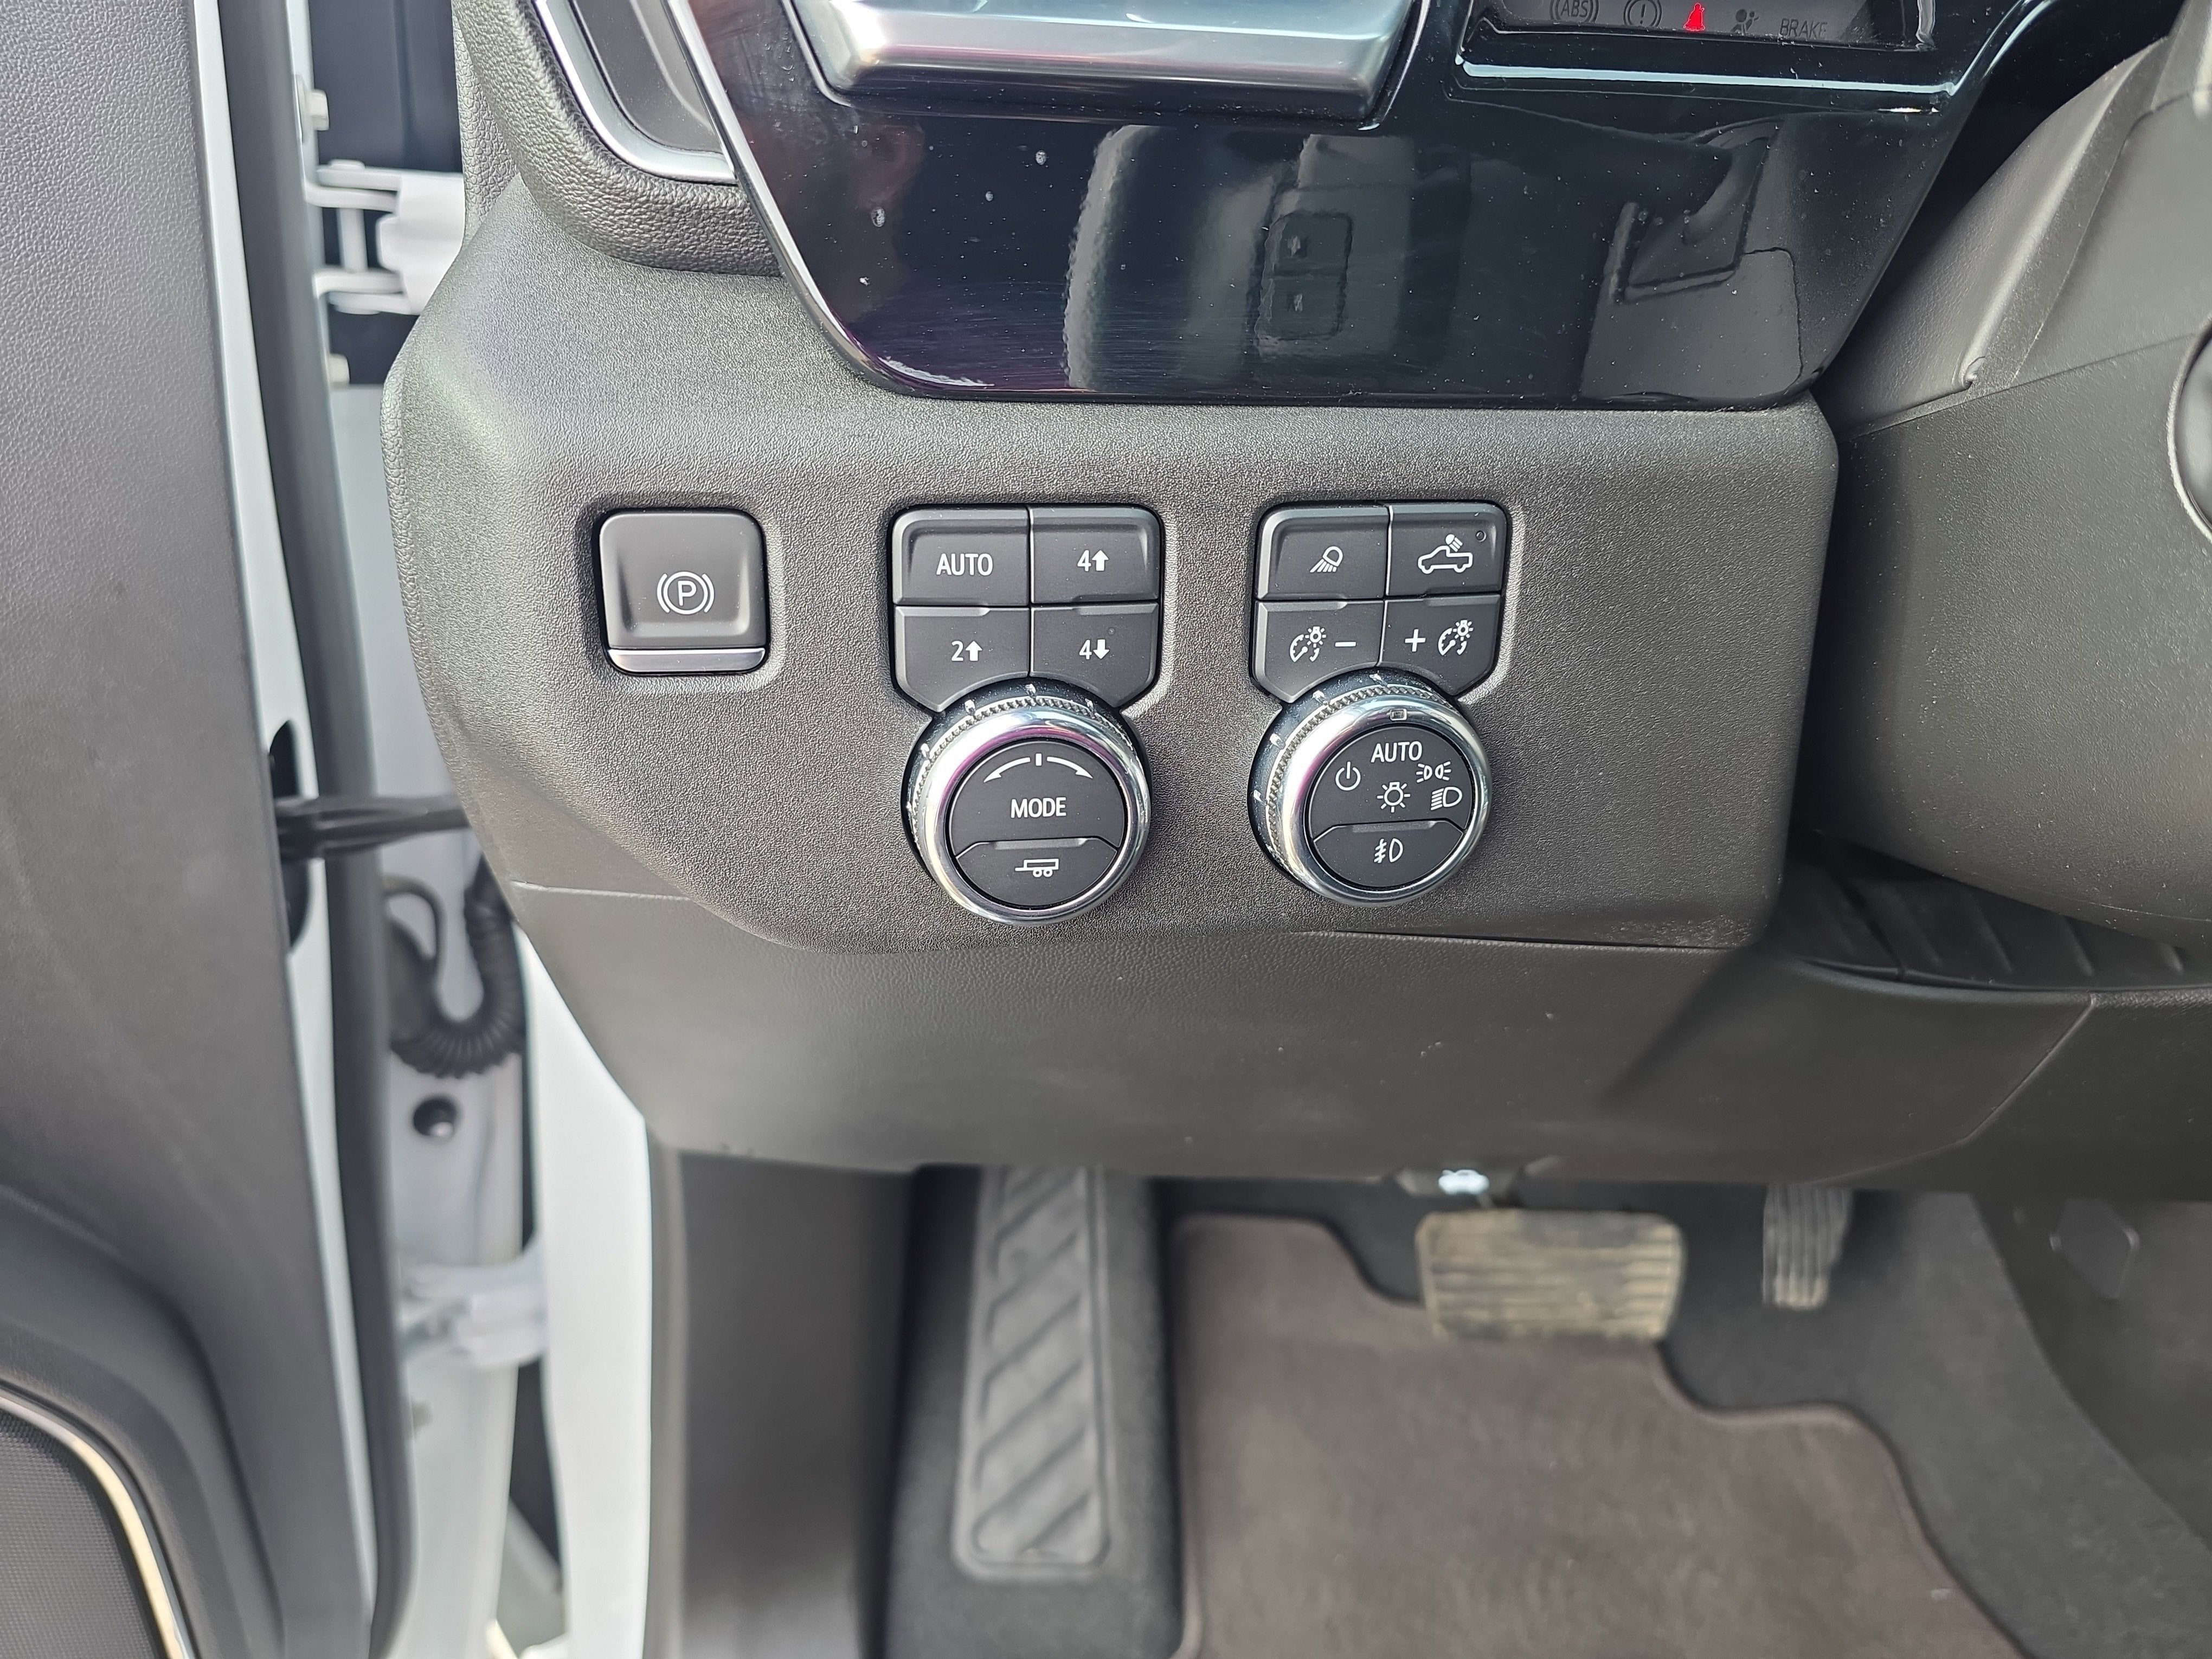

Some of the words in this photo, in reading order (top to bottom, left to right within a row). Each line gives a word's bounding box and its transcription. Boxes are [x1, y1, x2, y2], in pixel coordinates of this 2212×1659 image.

[1560, 0, 1589, 18] ABS
[936, 553, 993, 576] AUTO
[677, 580, 697, 607] P
[1371, 740, 1423, 763] AUTO
[1010, 796, 1066, 818] MODE
